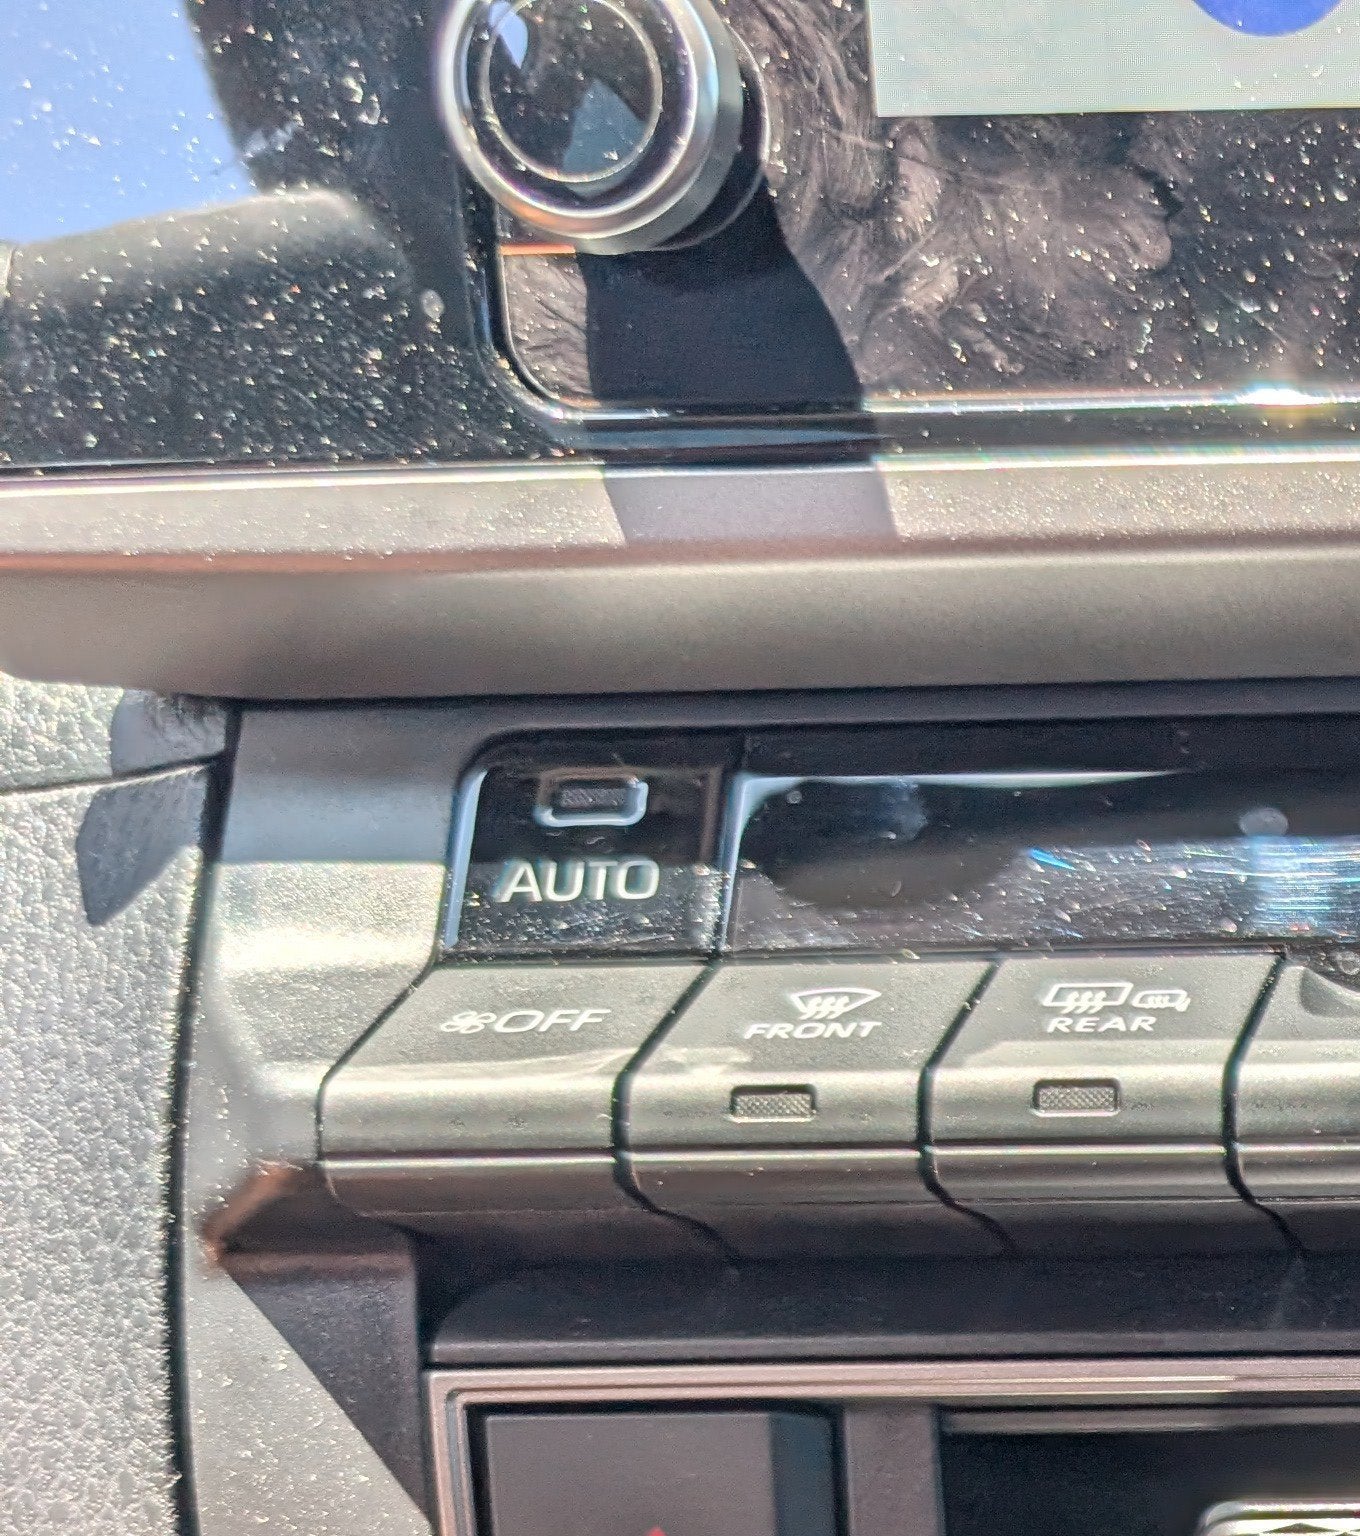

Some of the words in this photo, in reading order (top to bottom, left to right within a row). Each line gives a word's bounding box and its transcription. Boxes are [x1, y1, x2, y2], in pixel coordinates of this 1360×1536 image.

[498, 859, 662, 903] AUTO
[494, 1007, 613, 1034] OFF
[743, 1020, 883, 1040] FRONT
[1046, 1015, 1158, 1033] REAR
